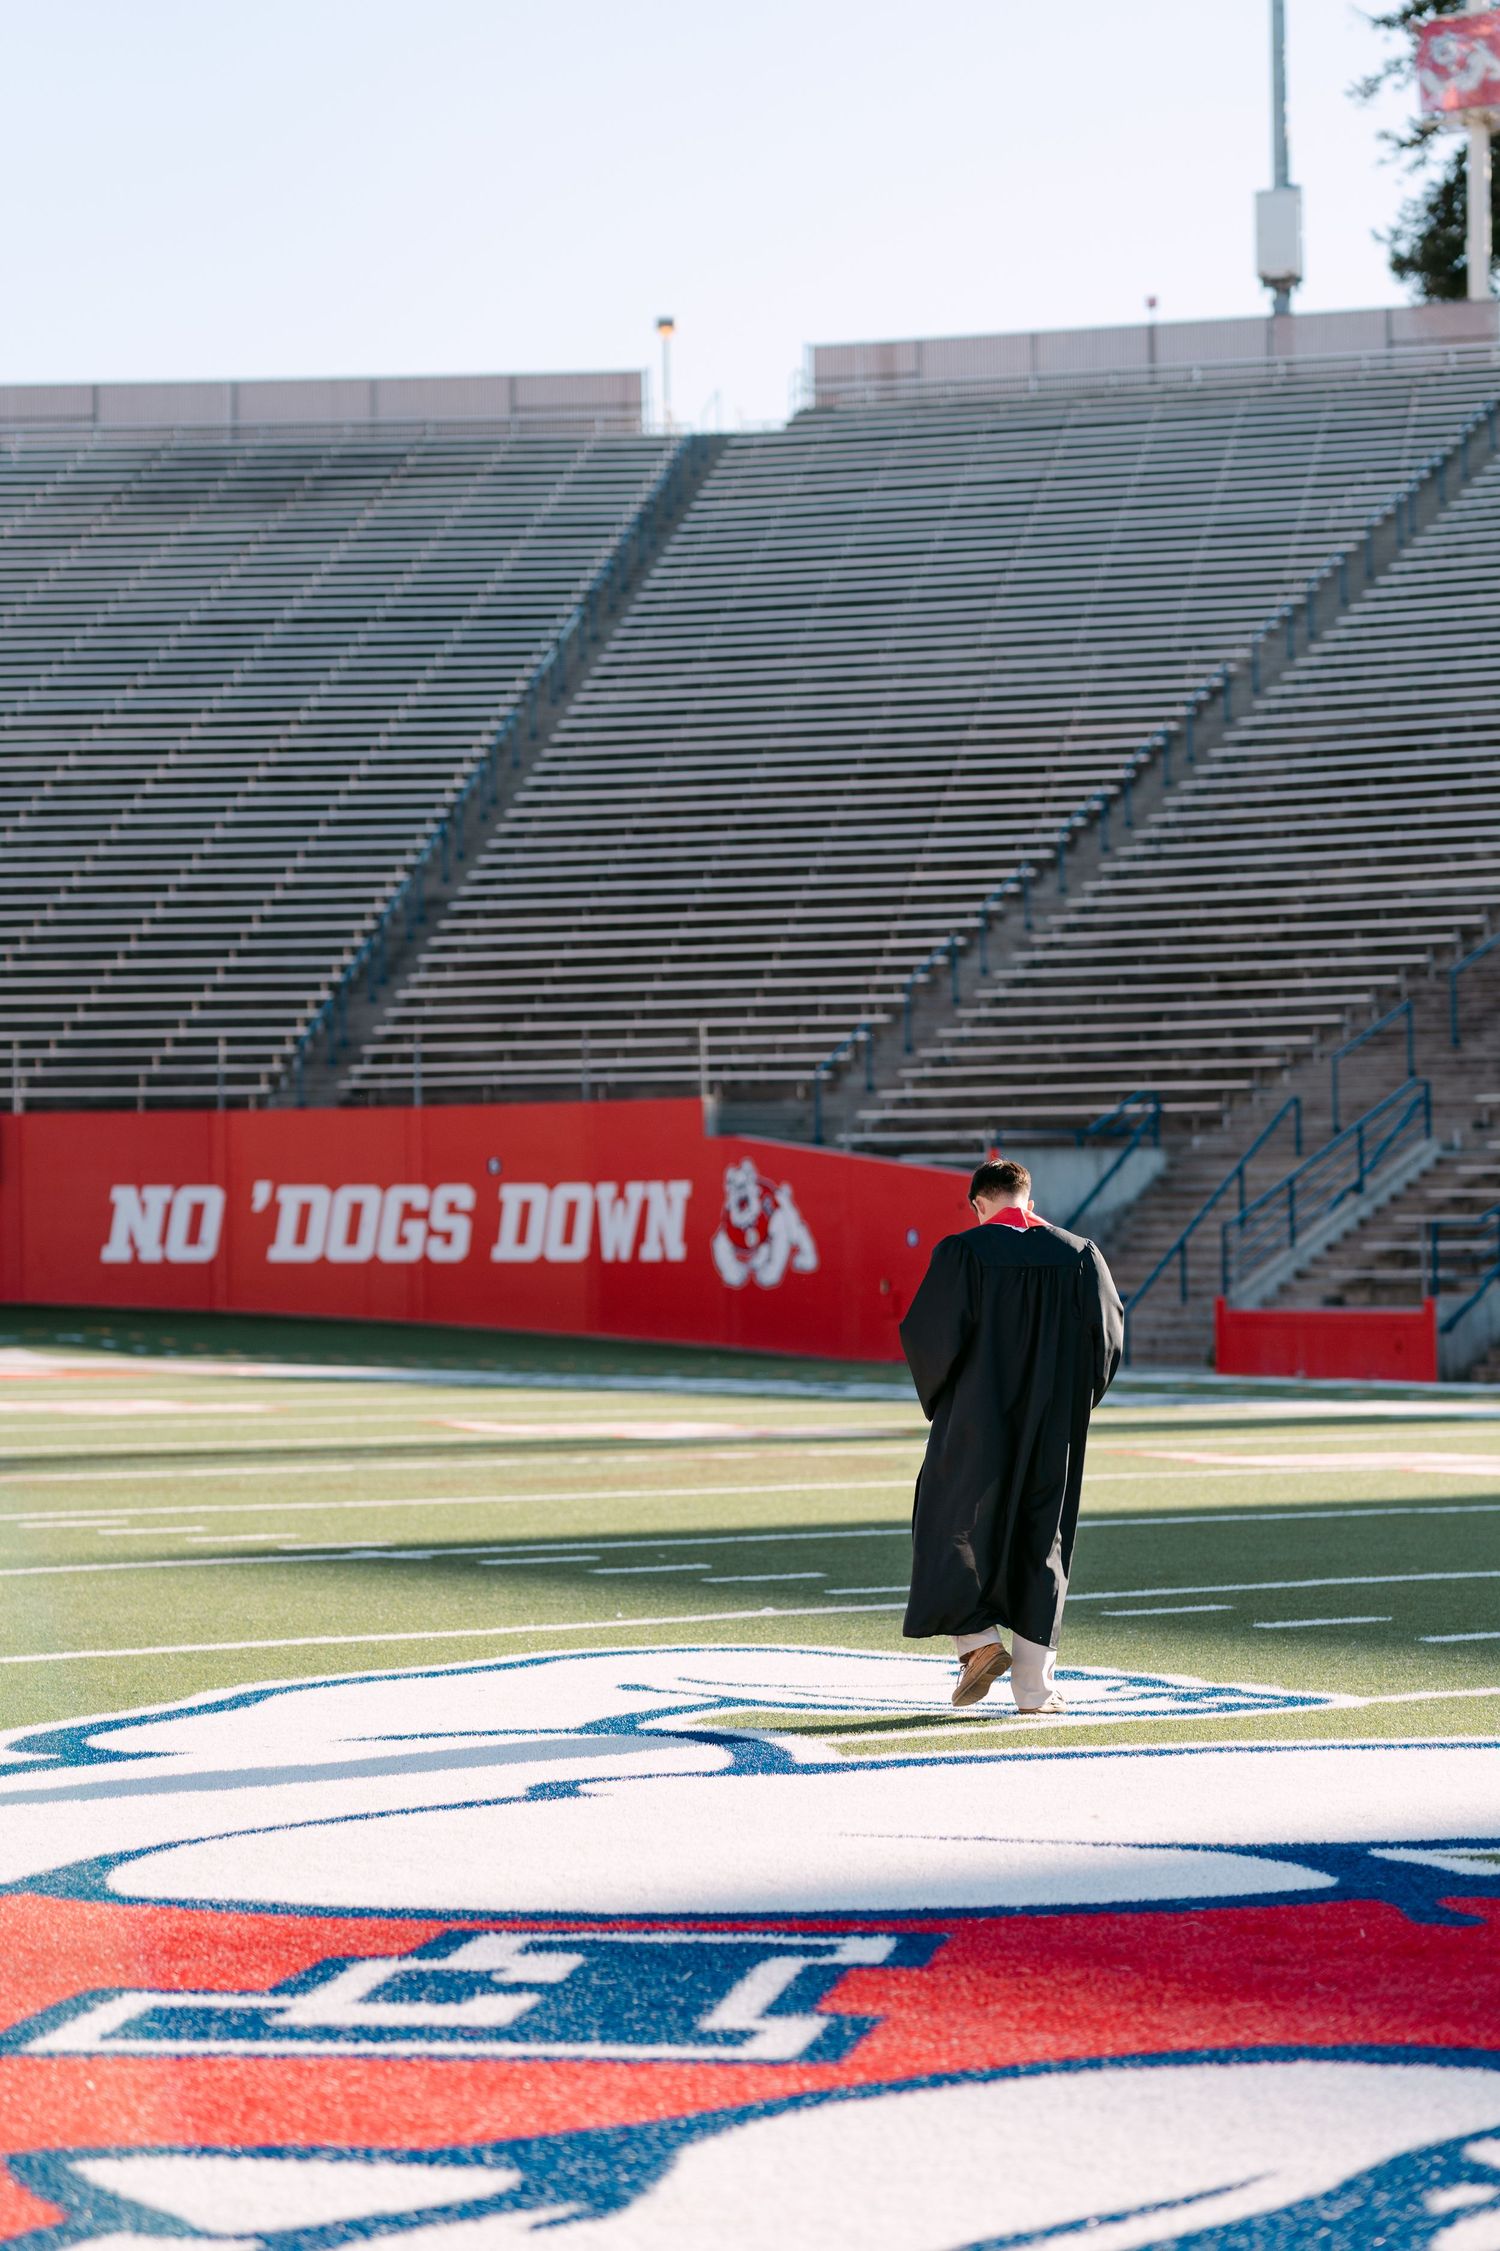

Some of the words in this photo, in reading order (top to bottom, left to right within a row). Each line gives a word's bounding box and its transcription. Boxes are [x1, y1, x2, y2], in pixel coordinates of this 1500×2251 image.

[100, 1185, 225, 1263] NO
[252, 1180, 475, 1263] 'DOGS
[491, 1180, 691, 1262] DOWN
